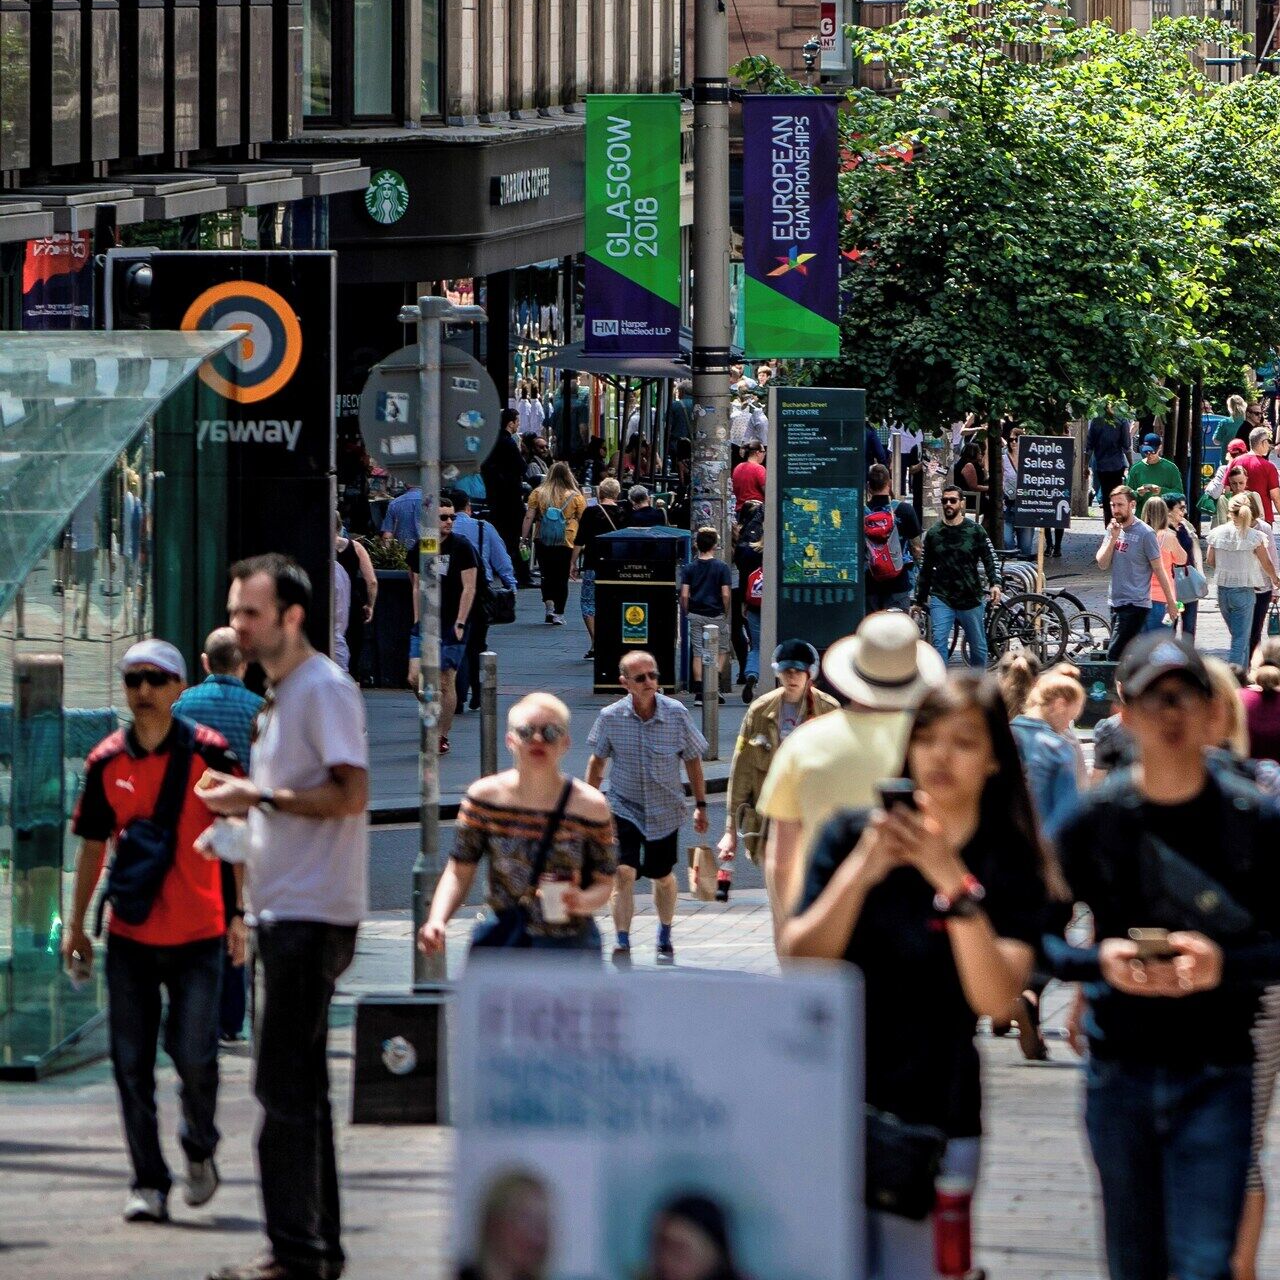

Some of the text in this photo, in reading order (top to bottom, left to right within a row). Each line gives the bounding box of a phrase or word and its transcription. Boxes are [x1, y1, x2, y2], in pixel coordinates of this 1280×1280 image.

[500, 167, 550, 206] STARBUCKS COFFEE
[607, 116, 632, 258] GLASGOW
[772, 115, 793, 241] EUROPEAN
[794, 116, 810, 240] CHAMPIONSHIPS
[634, 197, 659, 258] 2018
[620, 320, 648, 329] Harper
[620, 327, 672, 336] Macleod LLP
[1028, 442, 1063, 455] Apple
[1023, 457, 1066, 470] Sales &
[1022, 473, 1066, 487] Repairs
